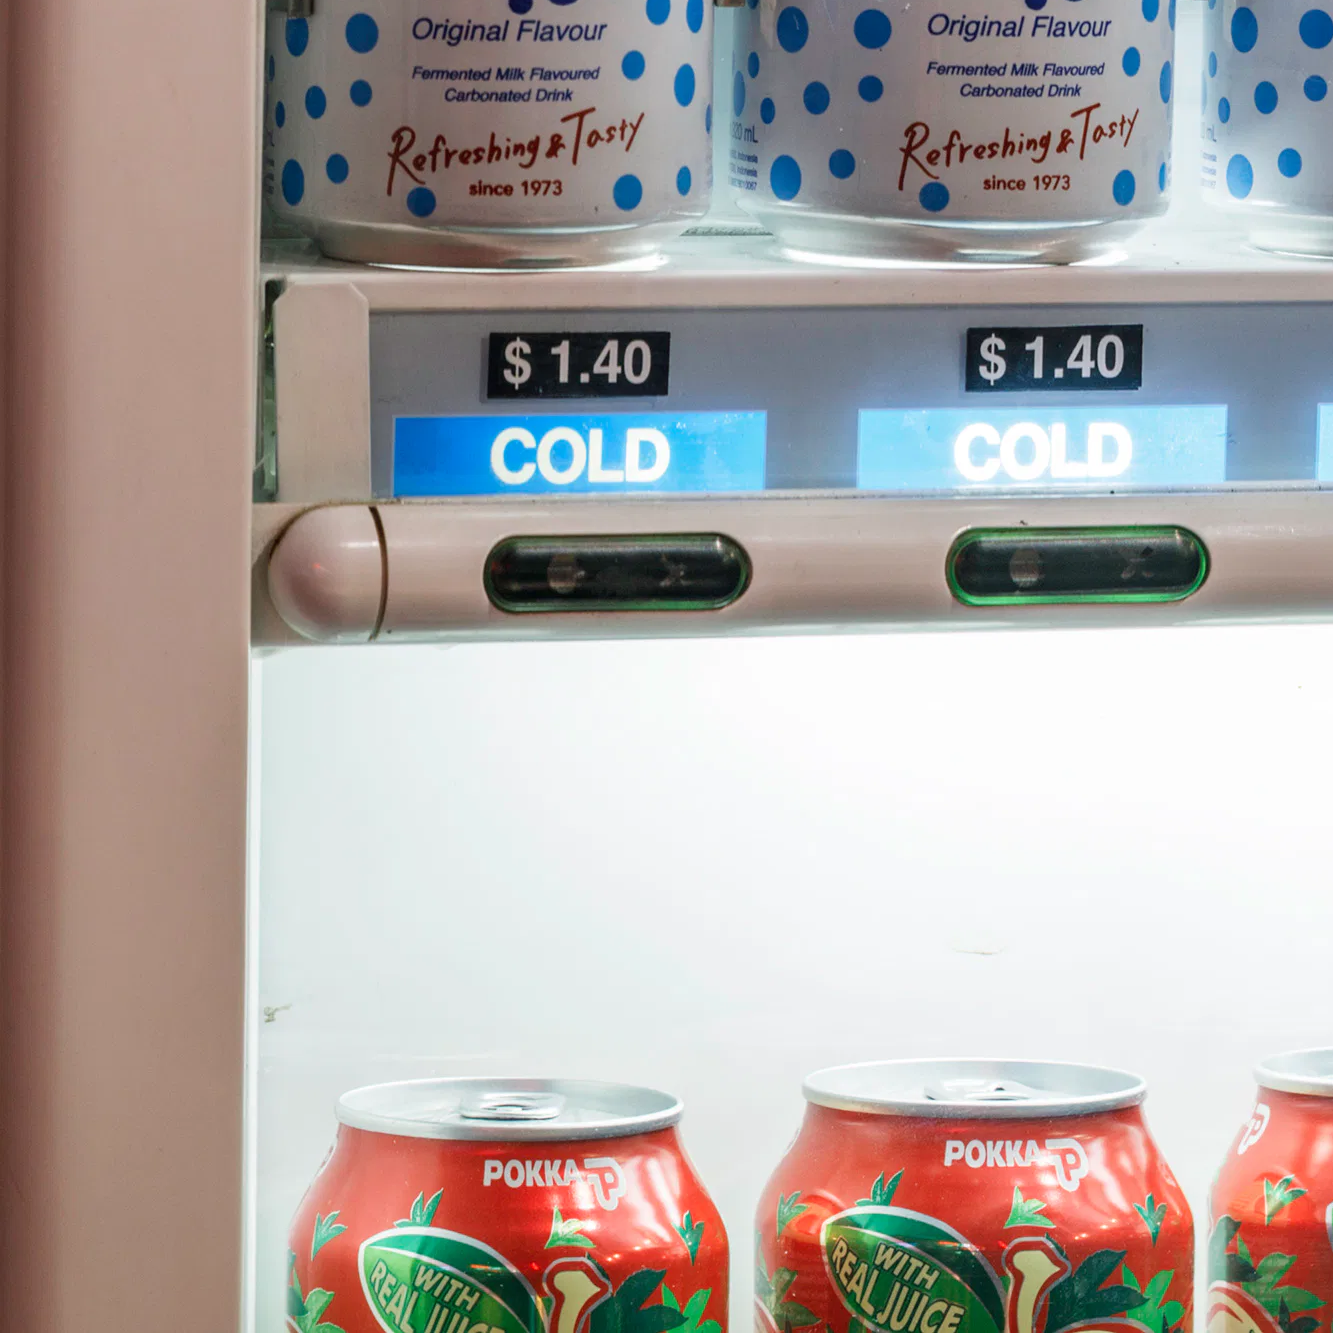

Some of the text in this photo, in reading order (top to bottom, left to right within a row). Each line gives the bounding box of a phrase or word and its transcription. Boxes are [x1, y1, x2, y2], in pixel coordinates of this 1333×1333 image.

[412, 16, 607, 46] Original Flavour
[927, 12, 1112, 43] Original Flavour
[412, 66, 600, 82] Fermented Milk Flavoured
[926, 62, 1105, 78] Fermented Milk Flavoured
[444, 88, 574, 103] Carbonated Drink
[959, 83, 1082, 99] Carbonated Drink
[386, 107, 646, 196] Refreshing & Tasty
[898, 102, 1140, 191] Refreshing & Tasty
[468, 180, 563, 197] since 1973
[983, 175, 1071, 192] since 1973
[503, 337, 652, 388] $ 1.40
[978, 334, 1124, 386] $ 1.40
[489, 427, 671, 484] COLD
[954, 421, 1133, 480] COLD
[483, 1158, 582, 1188] POKKA
[944, 1140, 1042, 1167] POKKA
[831, 1235, 967, 1333] REAL JUICE
[874, 1241, 942, 1290] WITH
[369, 1258, 417, 1333] REAL
[412, 1264, 482, 1313] WITH
